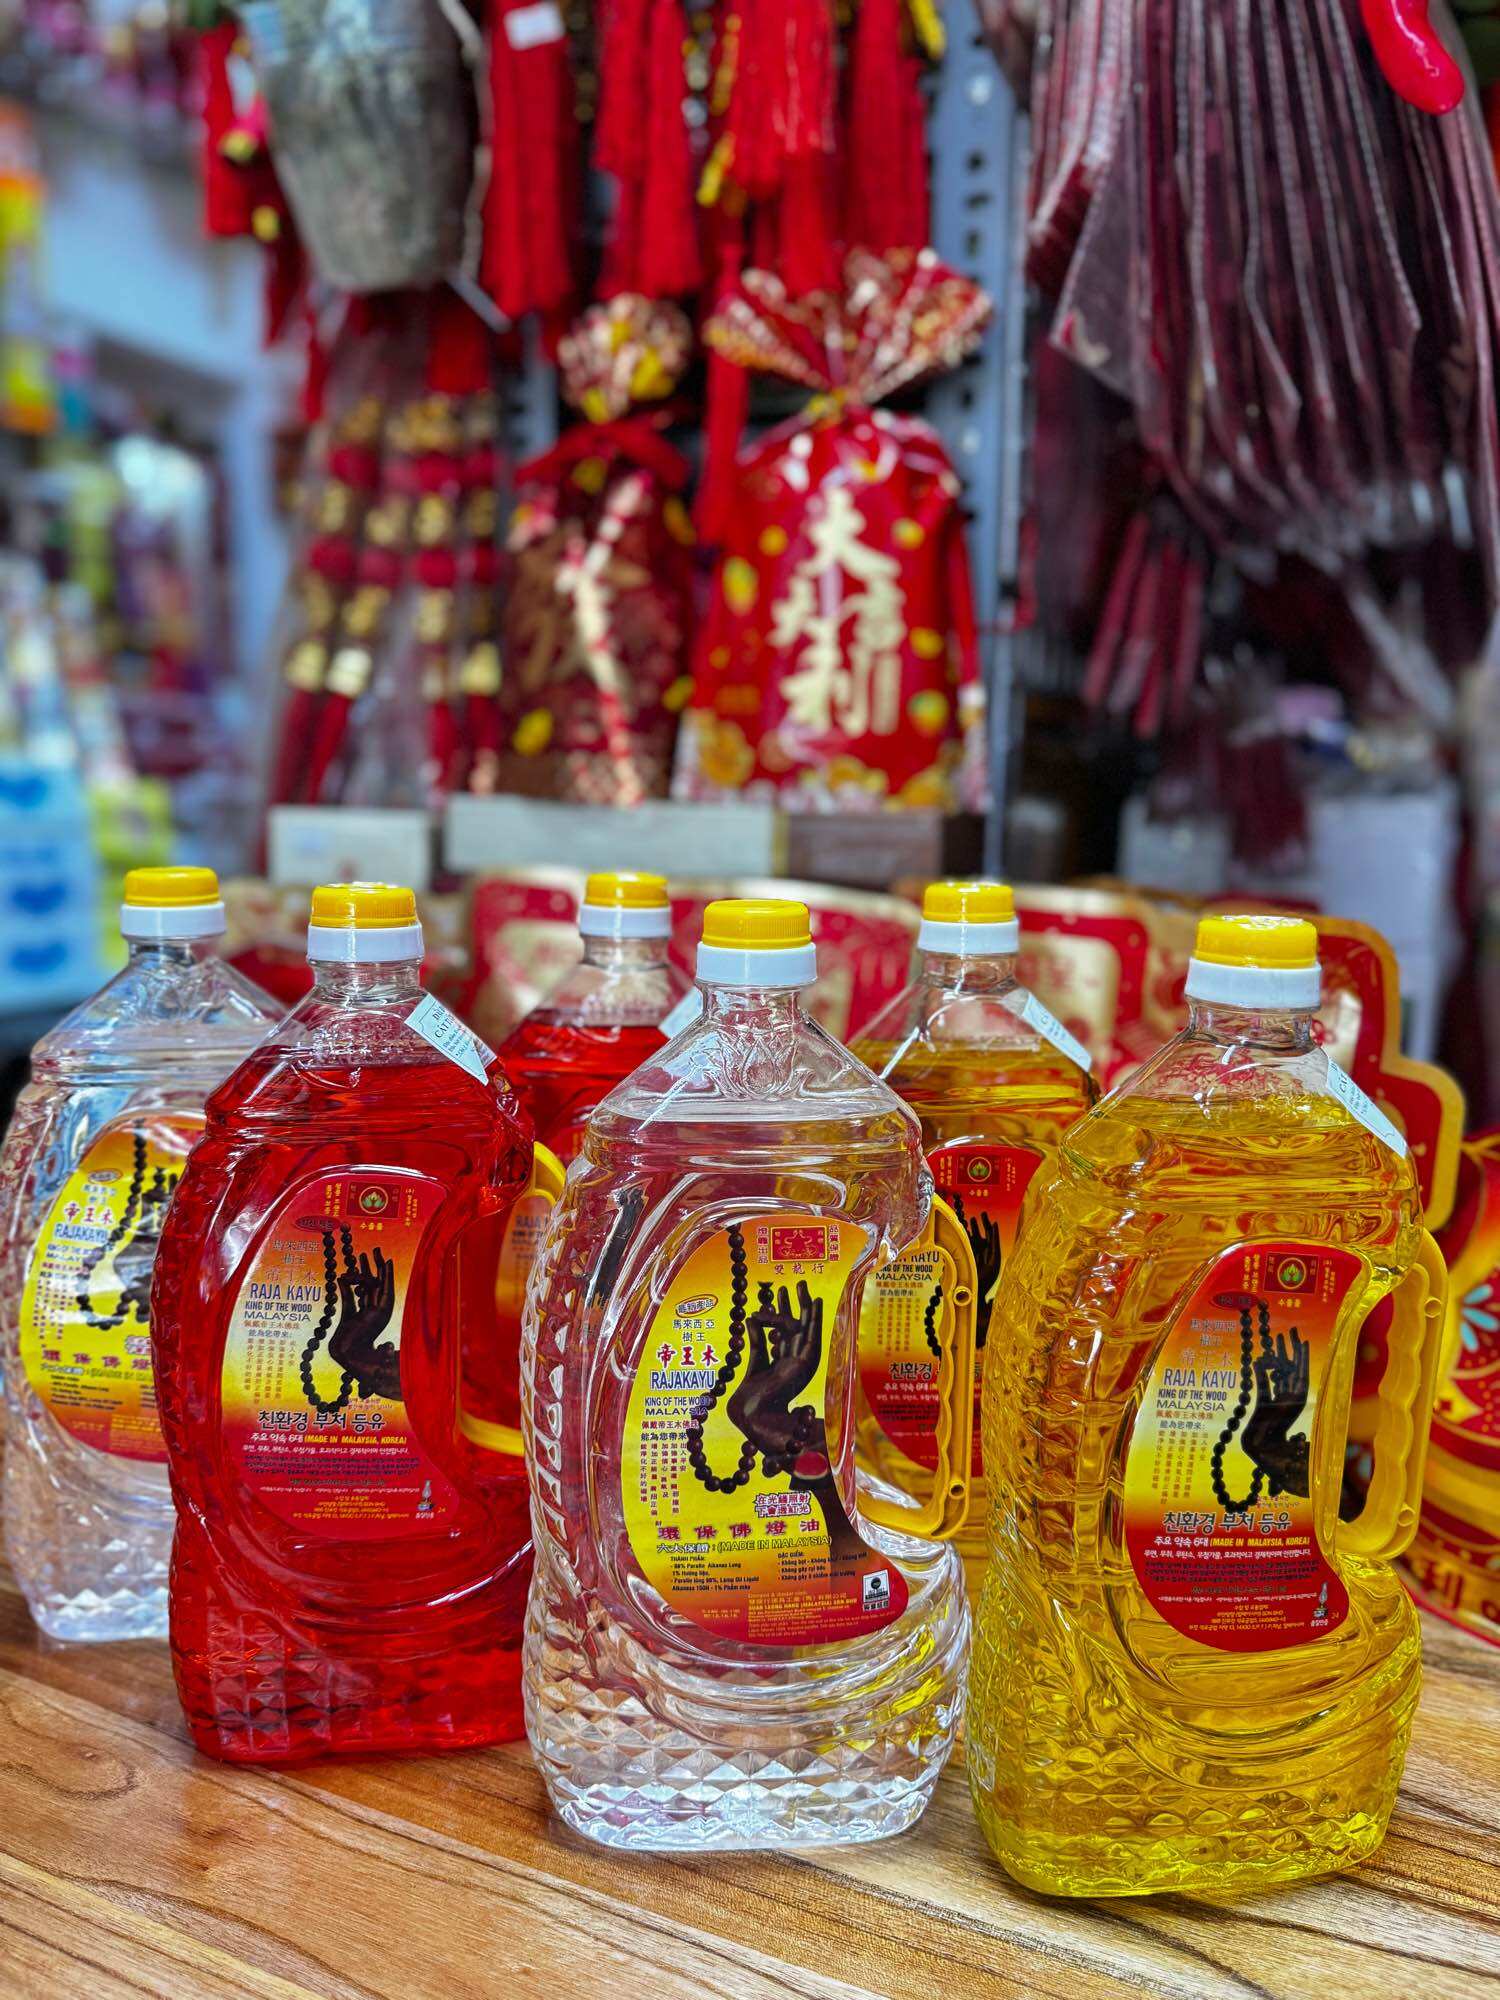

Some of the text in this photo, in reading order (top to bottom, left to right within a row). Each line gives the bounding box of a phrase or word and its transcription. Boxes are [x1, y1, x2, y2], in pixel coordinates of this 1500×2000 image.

[915, 1265, 933, 1273] WOOD
[875, 1272, 932, 1281] MALAYSIA
[250, 1283, 321, 1302] RAJA KAYU
[245, 1301, 312, 1313] KING OF THE WOOD
[244, 1311, 311, 1322] MALAYSIA
[673, 1319, 715, 1331] 馬來西亞
[682, 1331, 706, 1342] 樹王
[656, 1343, 719, 1369] 帝王木
[889, 1362, 932, 1380] 친환경
[650, 1370, 716, 1390] RAJAKAYU
[1164, 1368, 1237, 1389] RAJA KAYU
[645, 1396, 711, 1406] KING OF THE WOOD
[1158, 1389, 1227, 1401] KING OF THE WOOD
[645, 1407, 708, 1416] MALAYSIA
[1156, 1400, 1225, 1412] MALAYSIA
[258, 1410, 386, 1433] 친환경 부처 등유
[304, 1435, 328, 1444] (MADE
[329, 1435, 338, 1444] IN
[380, 1436, 407, 1445] KOREA)
[1163, 1511, 1291, 1534] 친환경 부처 등유
[658, 1519, 820, 1540] 環保佛燈油
[717, 1540, 755, 1553] (MADE
[757, 1539, 770, 1551] IN
[771, 1536, 833, 1550] MALAYSIA)
[1154, 1536, 1172, 1546] 주요
[1174, 1536, 1192, 1547] 약속
[1193, 1537, 1209, 1547] 6대
[1210, 1538, 1234, 1547] (MADE
[1235, 1538, 1244, 1547] IN
[1286, 1537, 1310, 1546] KOREA)
